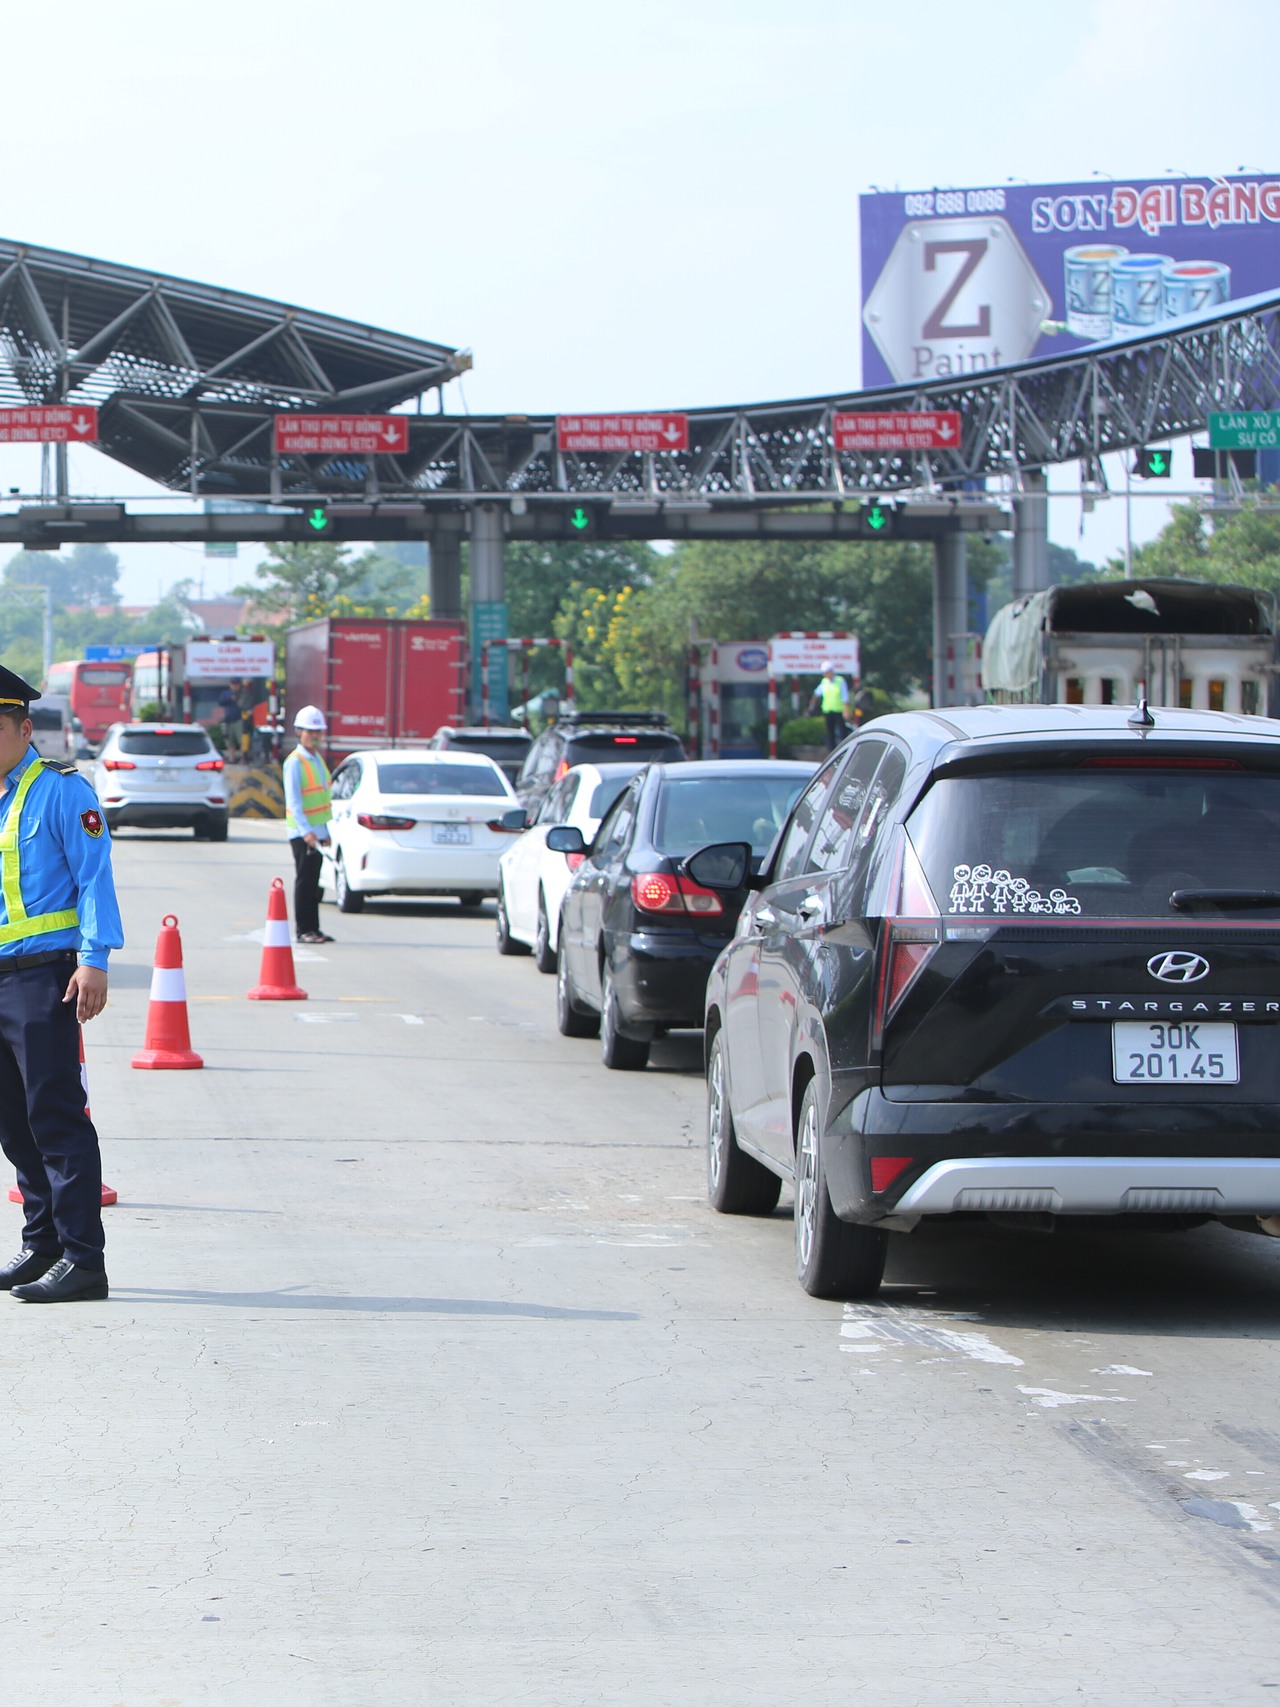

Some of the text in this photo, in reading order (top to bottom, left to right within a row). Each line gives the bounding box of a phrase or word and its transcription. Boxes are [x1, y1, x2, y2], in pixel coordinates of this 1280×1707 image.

[904, 193, 935, 217] 092
[1108, 185, 1177, 237] ĐẠI
[922, 237, 991, 339] Z
[911, 345, 1002, 377] Paint
[1072, 1000, 1280, 1012] STARGAZER
[1149, 1024, 1201, 1050] 30K
[1129, 1053, 1224, 1079] 201.45
